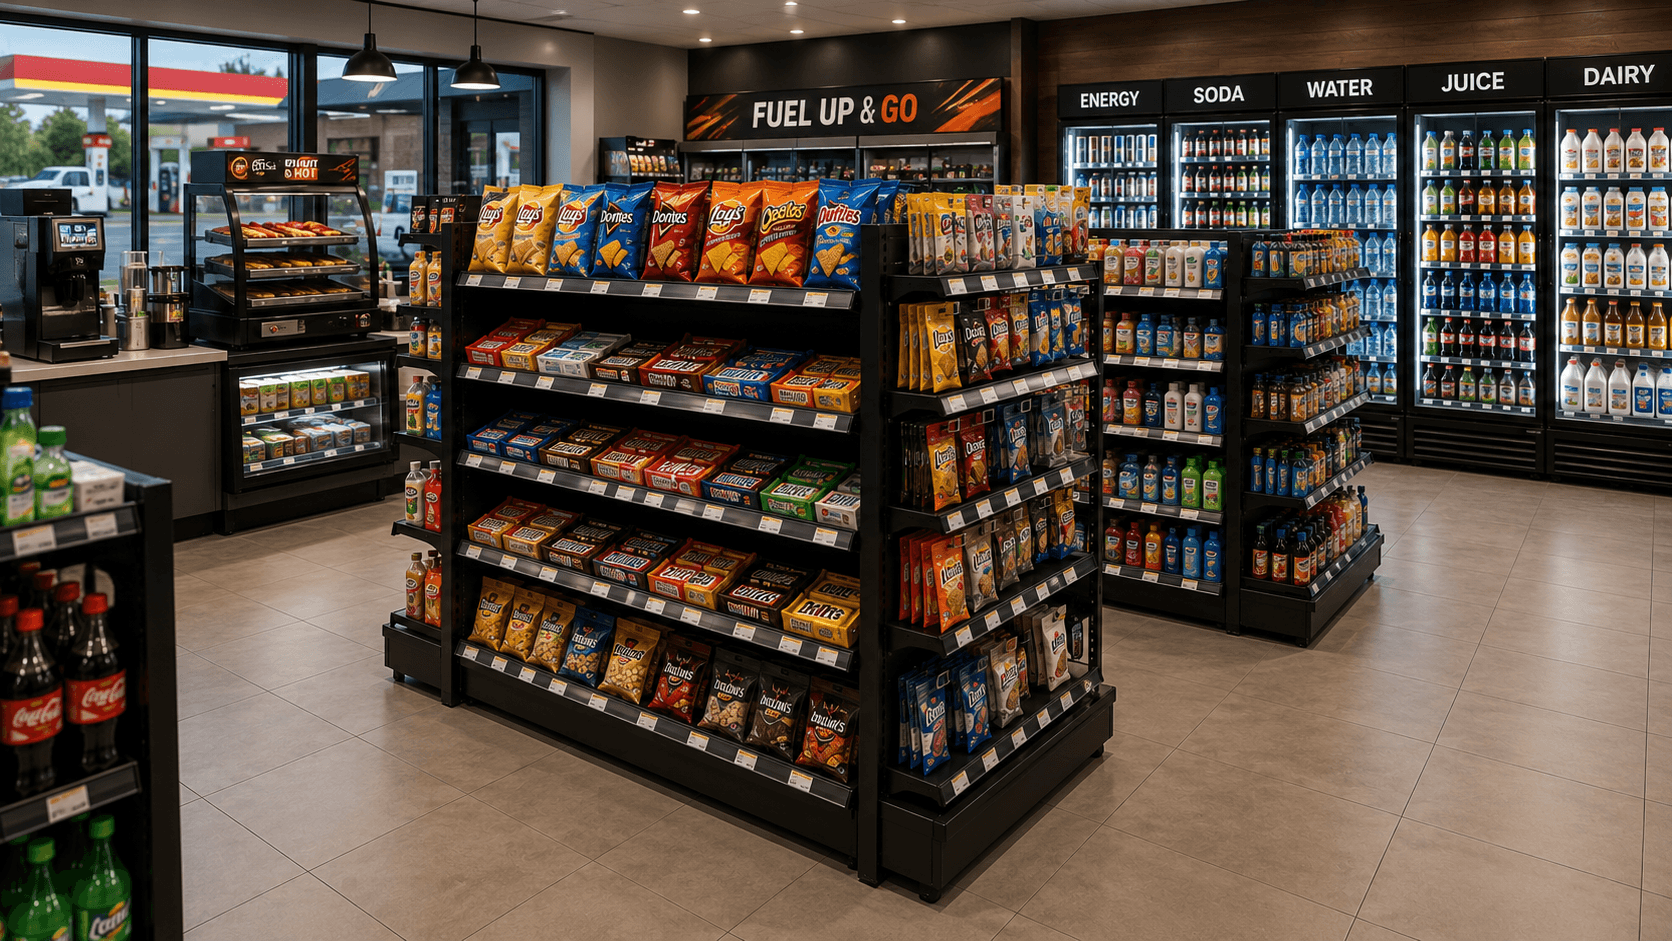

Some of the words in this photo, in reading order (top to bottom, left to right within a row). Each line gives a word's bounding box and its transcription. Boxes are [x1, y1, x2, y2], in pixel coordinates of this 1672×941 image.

[1441, 71, 1505, 92] JUICE
[1583, 64, 1655, 87] DAIRY
[1193, 85, 1245, 104] SODA
[1306, 78, 1373, 98] WATER
[1080, 90, 1140, 108] ENERGY
[752, 99, 812, 128] FUEL
[819, 97, 854, 126] UP
[860, 95, 875, 124] &
[881, 93, 918, 124] GO
[294, 167, 318, 178] HOT
